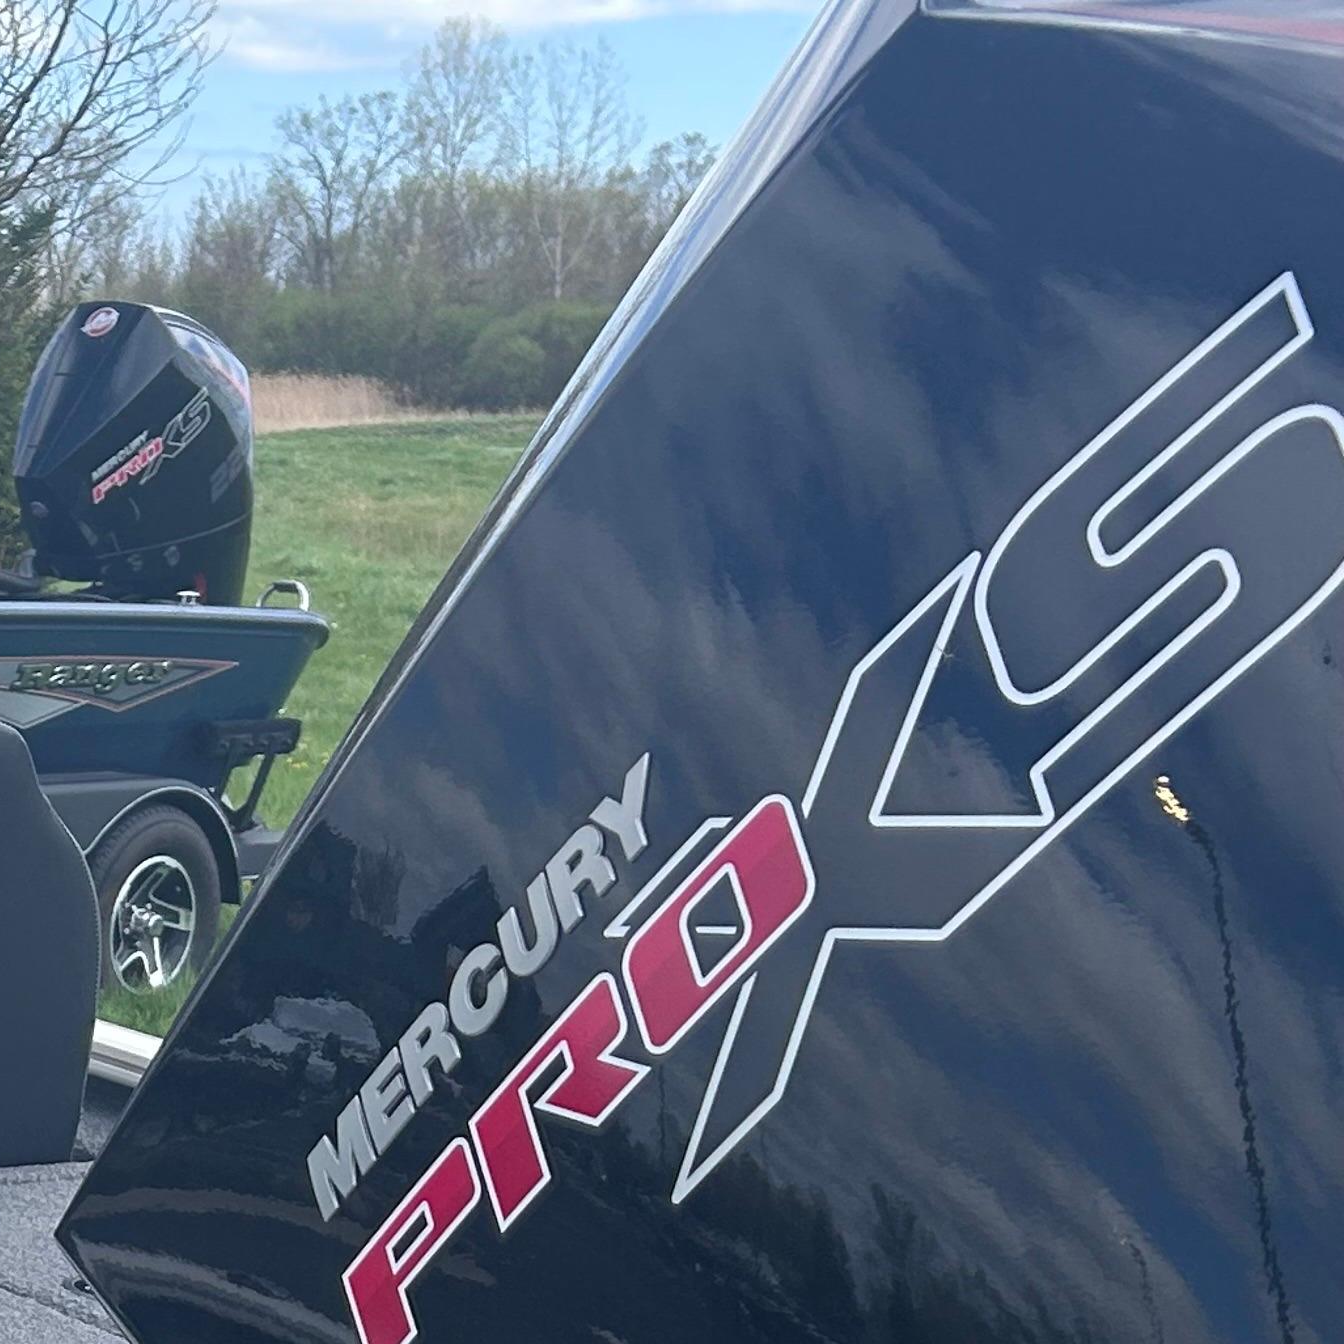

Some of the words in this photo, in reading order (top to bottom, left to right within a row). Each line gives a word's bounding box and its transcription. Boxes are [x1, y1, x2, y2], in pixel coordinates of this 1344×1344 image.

[92, 437, 163, 504] PRO
[11, 661, 171, 694] Ranger
[671, 270, 1344, 1204] XS
[307, 752, 651, 1222] MERCURY
